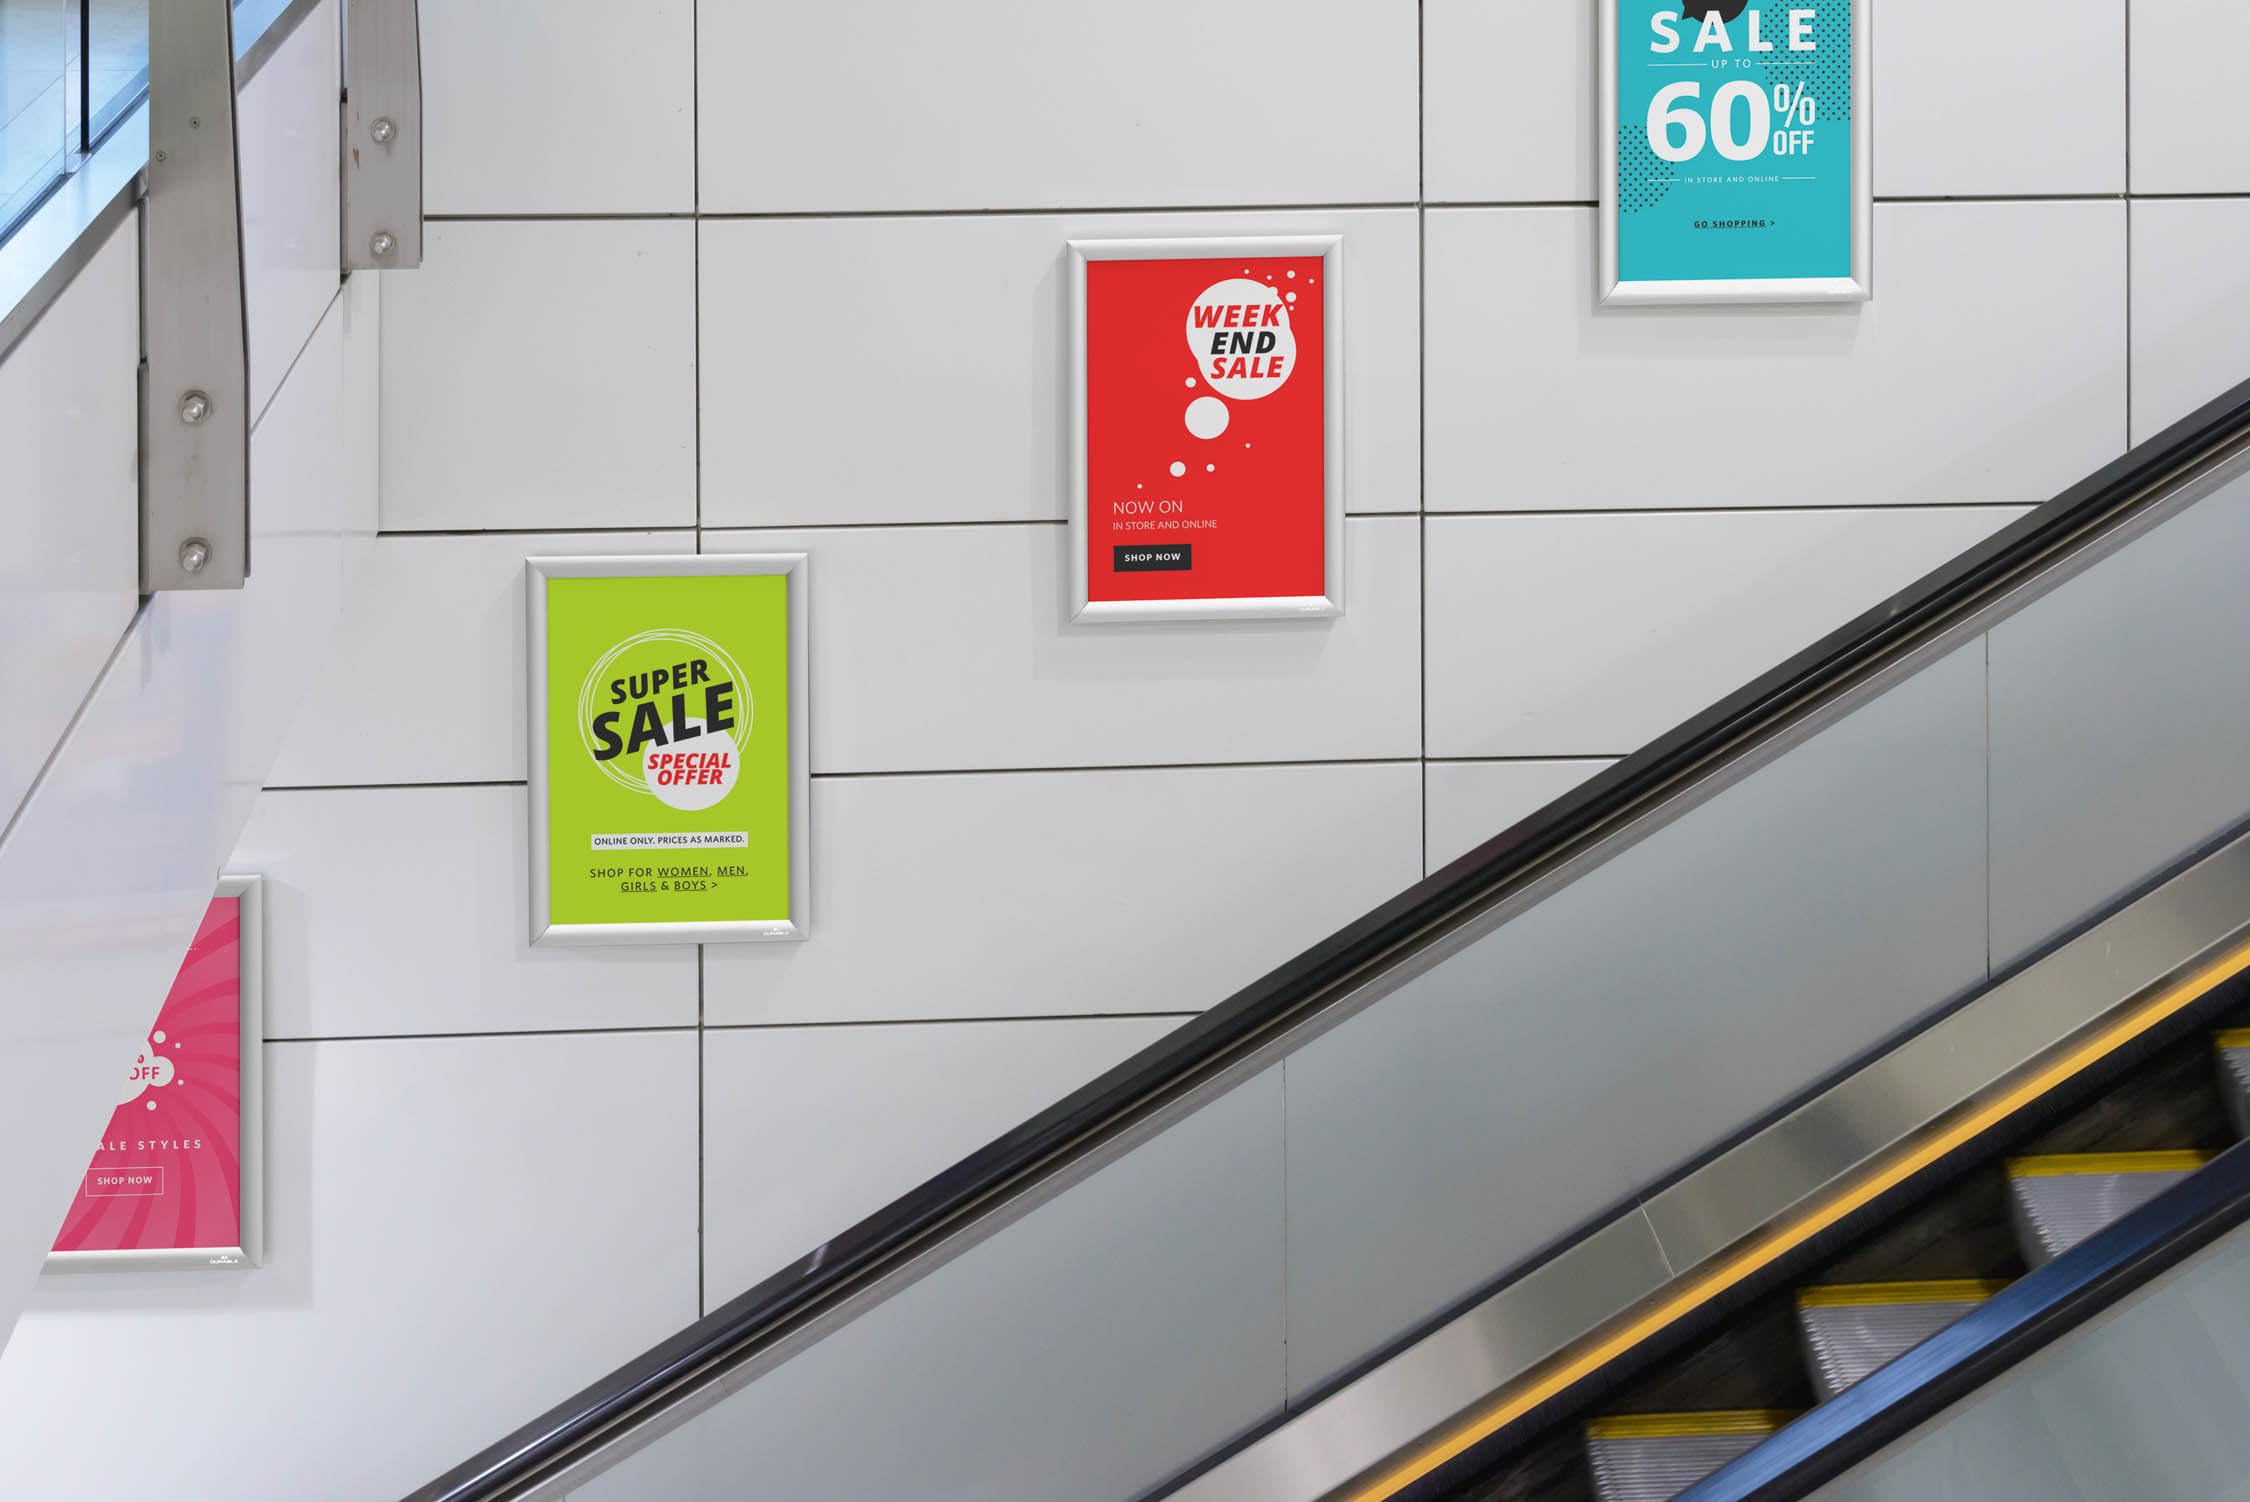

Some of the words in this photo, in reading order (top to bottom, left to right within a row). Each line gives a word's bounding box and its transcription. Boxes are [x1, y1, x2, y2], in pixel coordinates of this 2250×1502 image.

[1650, 9, 1816, 53] SALE
[1711, 58, 1728, 69] UP
[1733, 58, 1752, 69] TO
[1773, 130, 1814, 155] OFF
[1684, 176, 1694, 184] IN
[1696, 175, 1724, 184] STORE
[1726, 175, 1745, 183] AND
[1748, 174, 1779, 183] ONLINE
[1693, 220, 1709, 229] GO
[1712, 219, 1767, 229] SHOPPING
[1194, 303, 1283, 328] WEEK
[1210, 330, 1276, 355] END
[1210, 356, 1284, 379] SALE
[1113, 500, 1155, 515] NOW
[1158, 499, 1183, 514] ON
[1112, 521, 1123, 531] IN
[1125, 520, 1155, 530] STORE
[1157, 519, 1180, 529] AND
[1181, 519, 1217, 529] ONLINE
[1124, 553, 1153, 562] SHOP
[1155, 552, 1181, 561] NOW
[610, 659, 711, 704] SUPER
[592, 681, 735, 761] SALE
[647, 752, 732, 770] SPECIAL
[657, 769, 723, 785] OFFER
[594, 837, 627, 846] ONLINE
[657, 836, 688, 845] PRICES
[690, 835, 702, 844] AS
[704, 834, 745, 844] MARKED.
[589, 867, 624, 879] SHOP
[628, 867, 653, 878] FOR
[620, 881, 658, 893] GIRLS
[660, 880, 670, 891] &
[674, 880, 707, 892] BOYS
[138, 1139, 201, 1151] STYLES
[97, 1176, 125, 1186] SHOP
[127, 1175, 153, 1185] NOW
